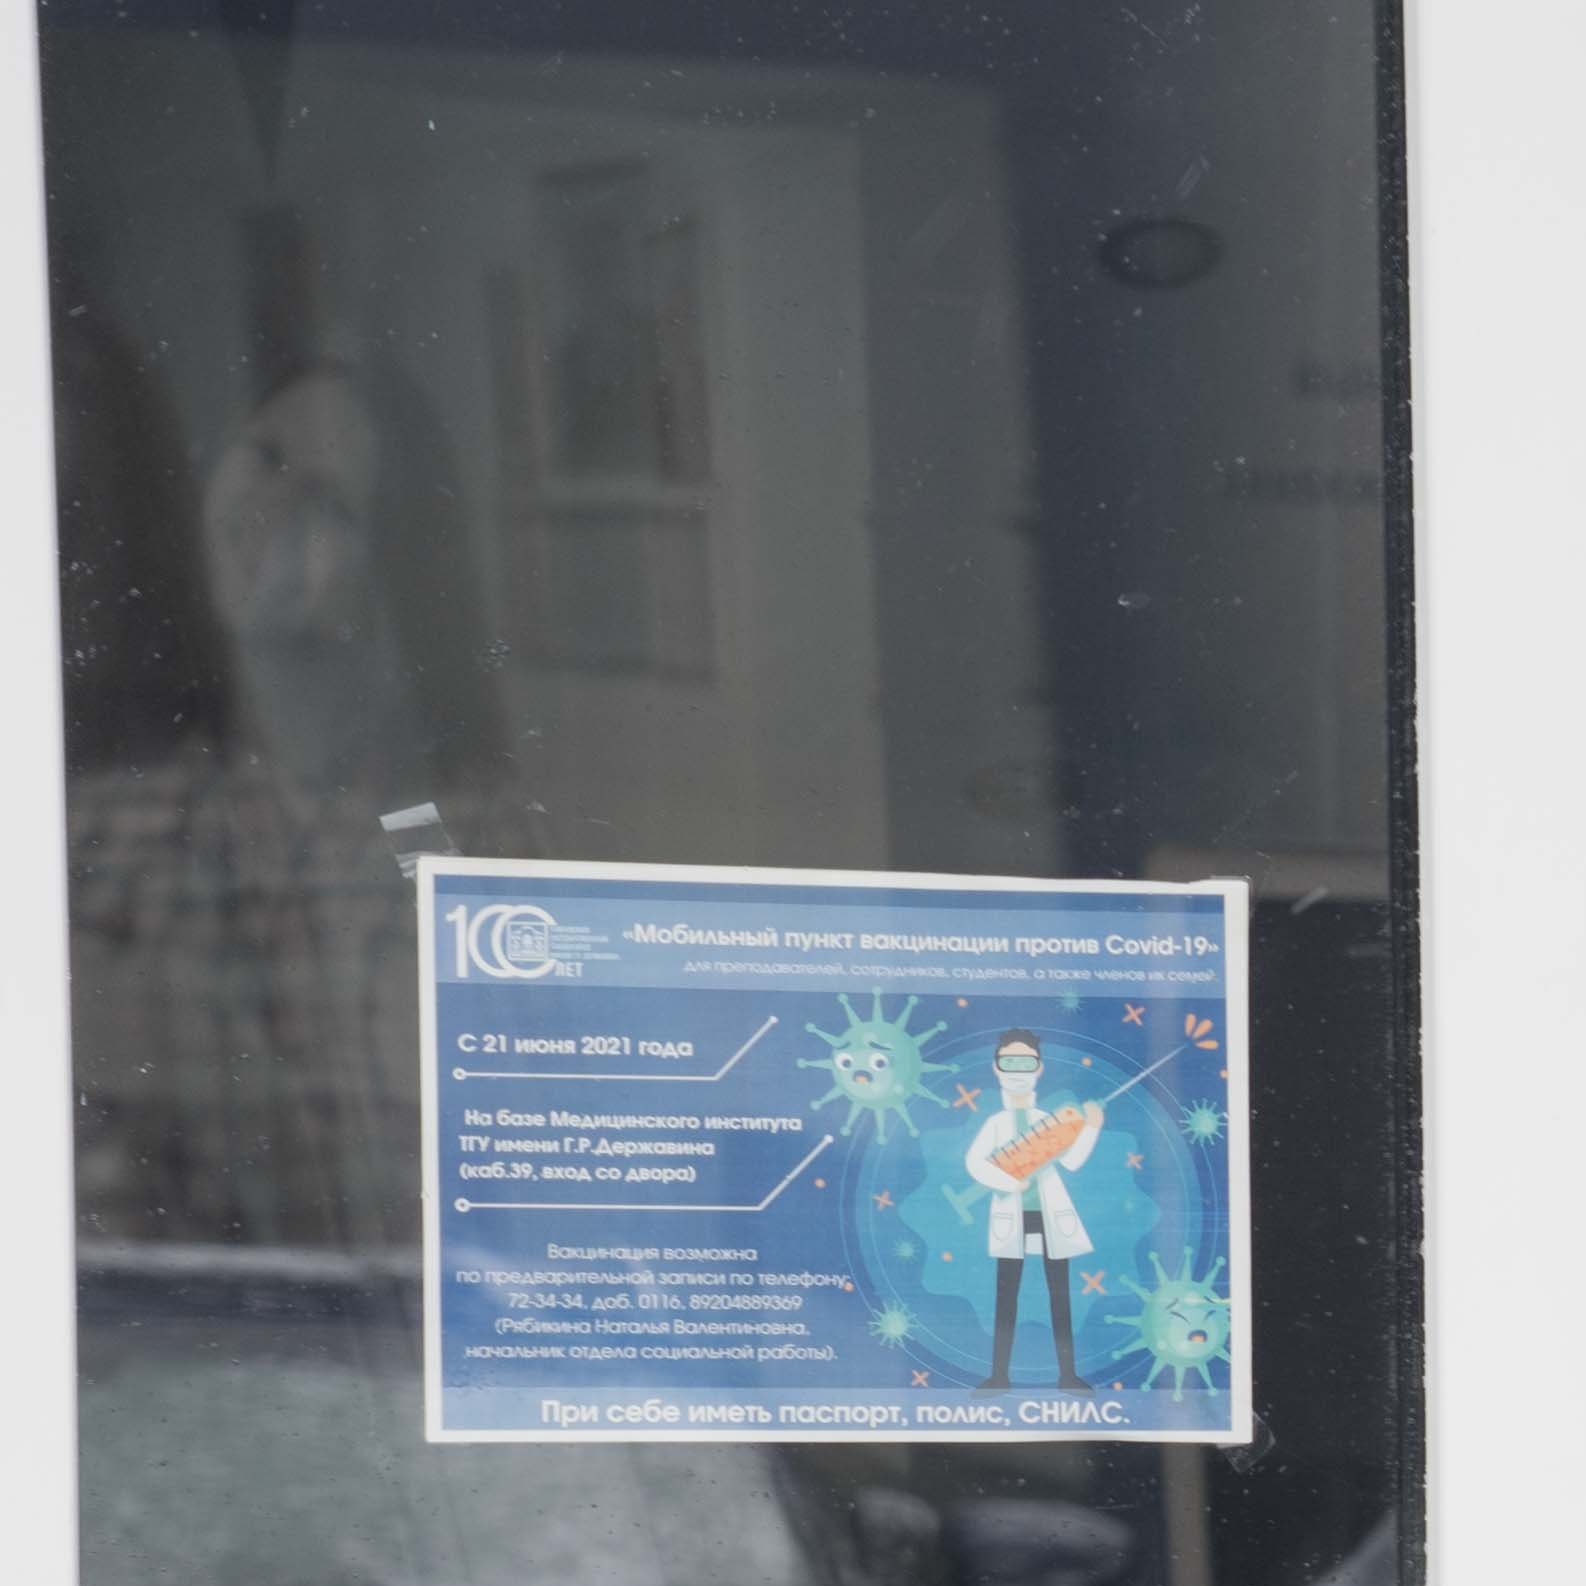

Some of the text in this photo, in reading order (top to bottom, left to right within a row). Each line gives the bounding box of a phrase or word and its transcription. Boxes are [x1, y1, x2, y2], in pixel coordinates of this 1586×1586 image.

[622, 922, 778, 948] «Мобильный
[785, 930, 854, 952] пункт
[860, 933, 1009, 956] вакцинации
[1015, 936, 1099, 957] против
[1105, 934, 1219, 956] Covid-19»
[457, 1033, 694, 1058] С 21 июня 2021 года
[464, 1109, 803, 1134] На базе Медицинского института
[458, 1136, 715, 1158] ТГУ имени Г.Р.Державина
[459, 1163, 696, 1184] (каб.39, вход со двора)
[547, 1243, 758, 1262] Вакцинация возможна
[456, 1269, 481, 1284] по
[485, 1269, 654, 1288] предварительной
[658, 1272, 725, 1287] записи
[731, 1273, 754, 1287] по
[594, 1319, 670, 1335] Наталья
[465, 1345, 565, 1359] начальник
[569, 1345, 637, 1361] отдела
[640, 1344, 754, 1361] социальной
[541, 1400, 1130, 1428] При себе иметь паспорт, полис, СНИЛС.
